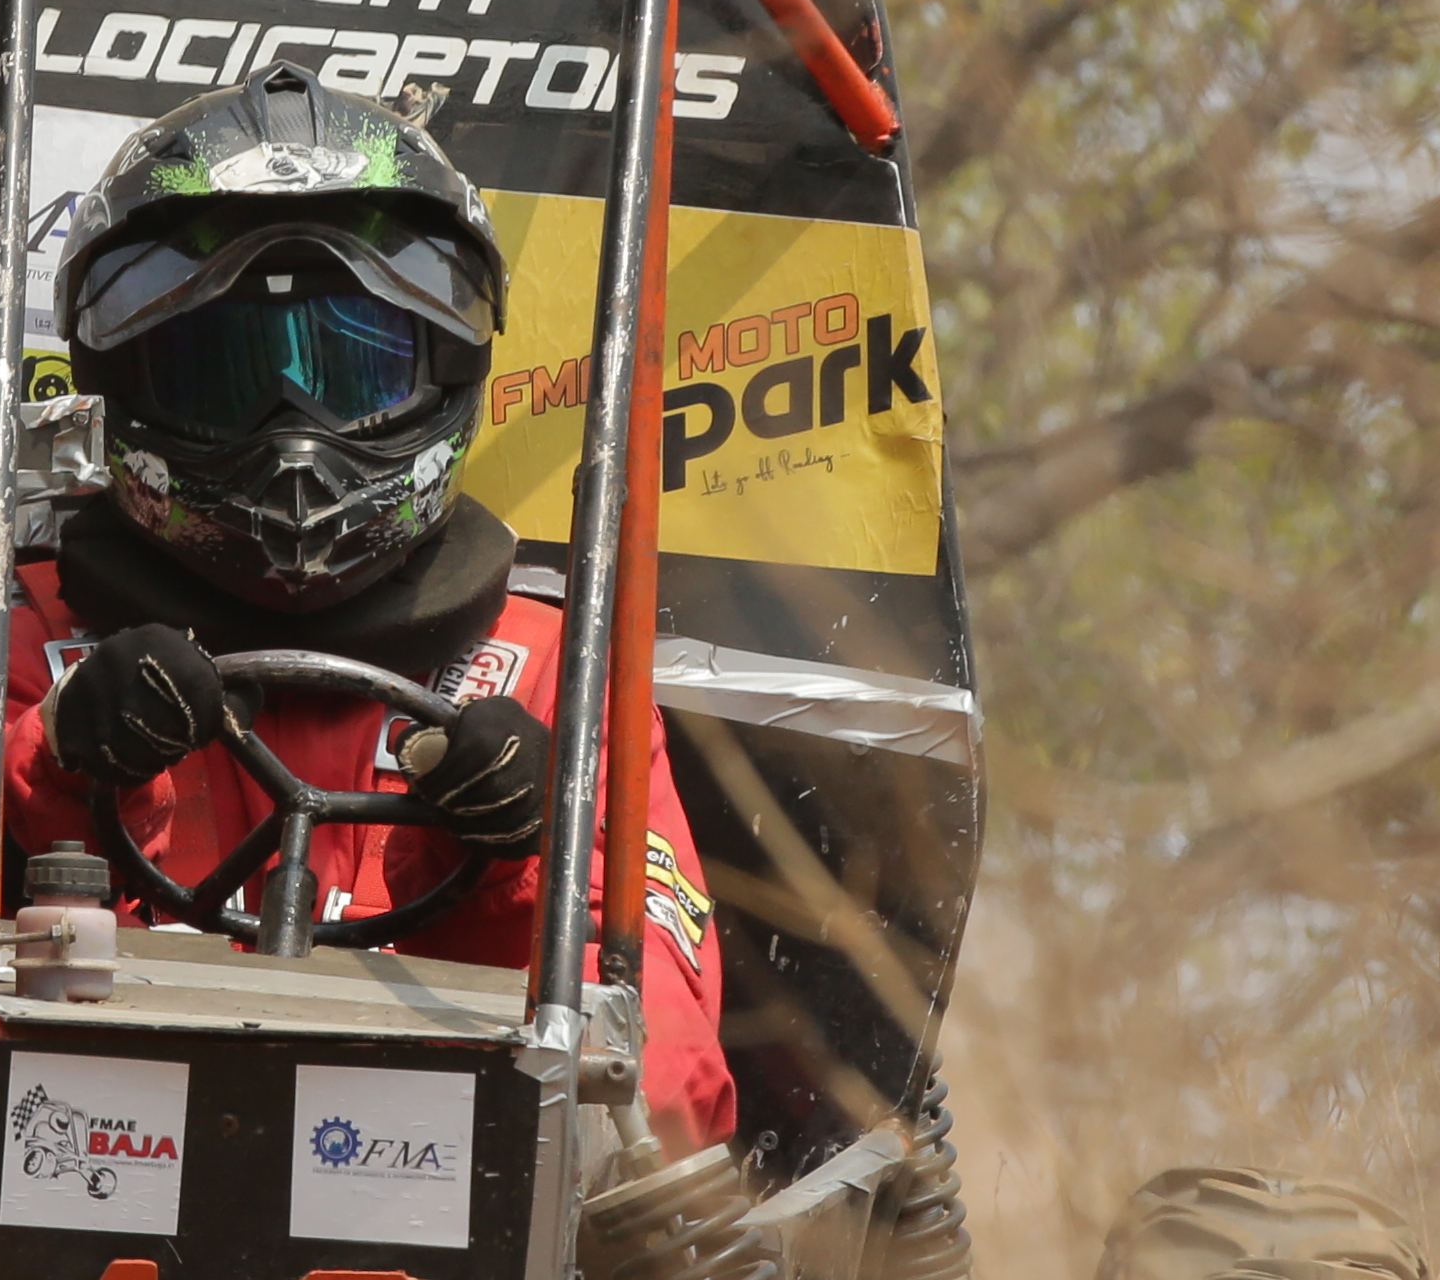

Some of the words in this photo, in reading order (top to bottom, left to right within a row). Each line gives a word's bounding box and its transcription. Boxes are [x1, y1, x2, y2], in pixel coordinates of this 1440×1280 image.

[678, 292, 860, 381] MOTO
[89, 1117, 137, 1133] FMAE
[88, 1131, 179, 1160] BAJA
